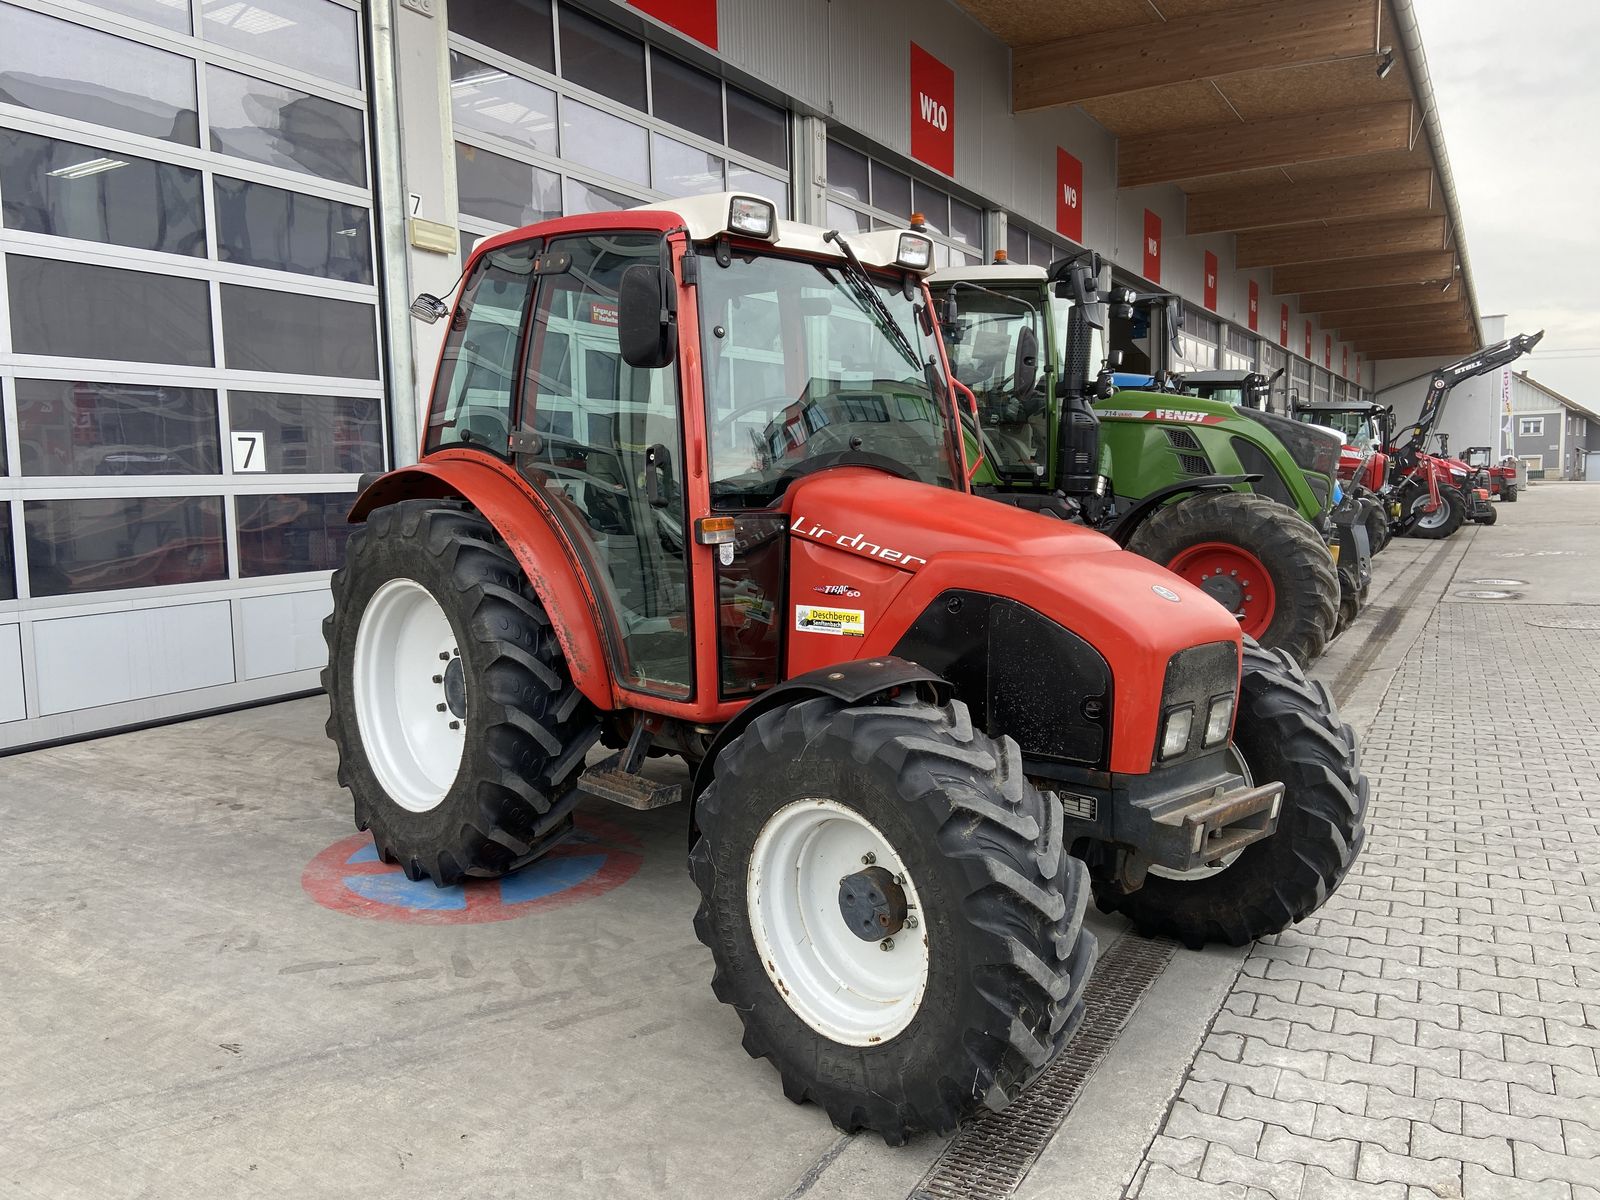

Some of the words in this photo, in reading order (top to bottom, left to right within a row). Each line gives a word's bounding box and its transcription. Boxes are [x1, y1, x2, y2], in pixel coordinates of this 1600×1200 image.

[919, 91, 948, 132] W10
[410, 194, 421, 215] 7
[1063, 183, 1077, 209] W9
[1454, 360, 1482, 375] STOLL
[1155, 408, 1208, 423] FENDT
[237, 437, 256, 469] 7
[846, 590, 861, 598] 60
[812, 610, 859, 623] Deschberger
